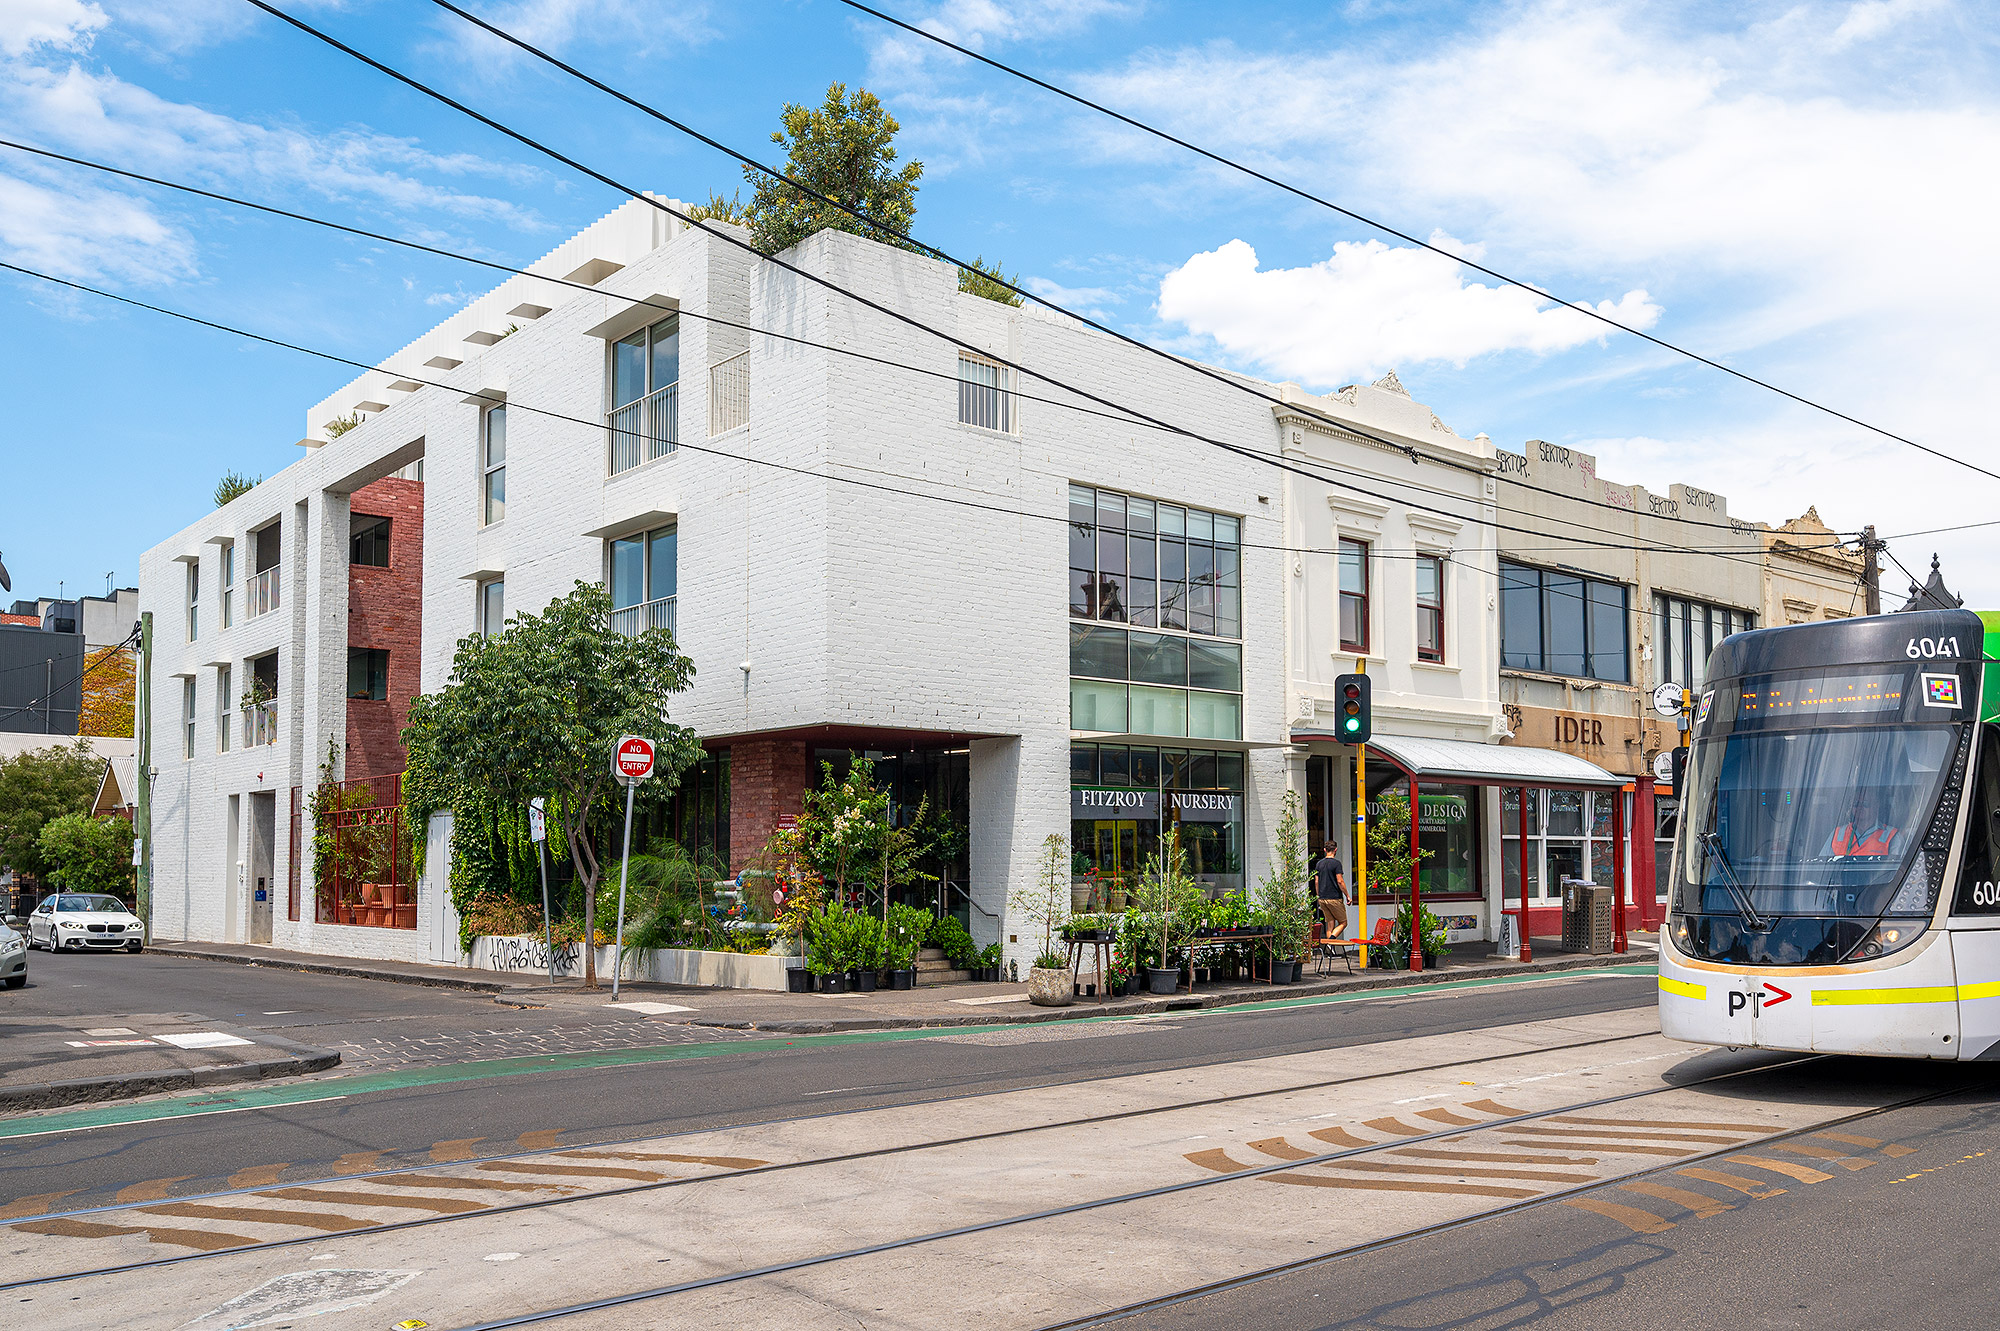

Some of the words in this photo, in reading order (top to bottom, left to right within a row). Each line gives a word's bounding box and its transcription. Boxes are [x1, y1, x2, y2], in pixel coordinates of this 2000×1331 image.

[1906, 636, 1960, 659] 6041
[1555, 716, 1606, 746] IDER
[630, 745, 642, 753] NO
[622, 762, 647, 771] ENTRY
[1081, 789, 1147, 807] FITZROY
[1171, 793, 1235, 810] NURSERY
[1424, 803, 1467, 818] DESIGN
